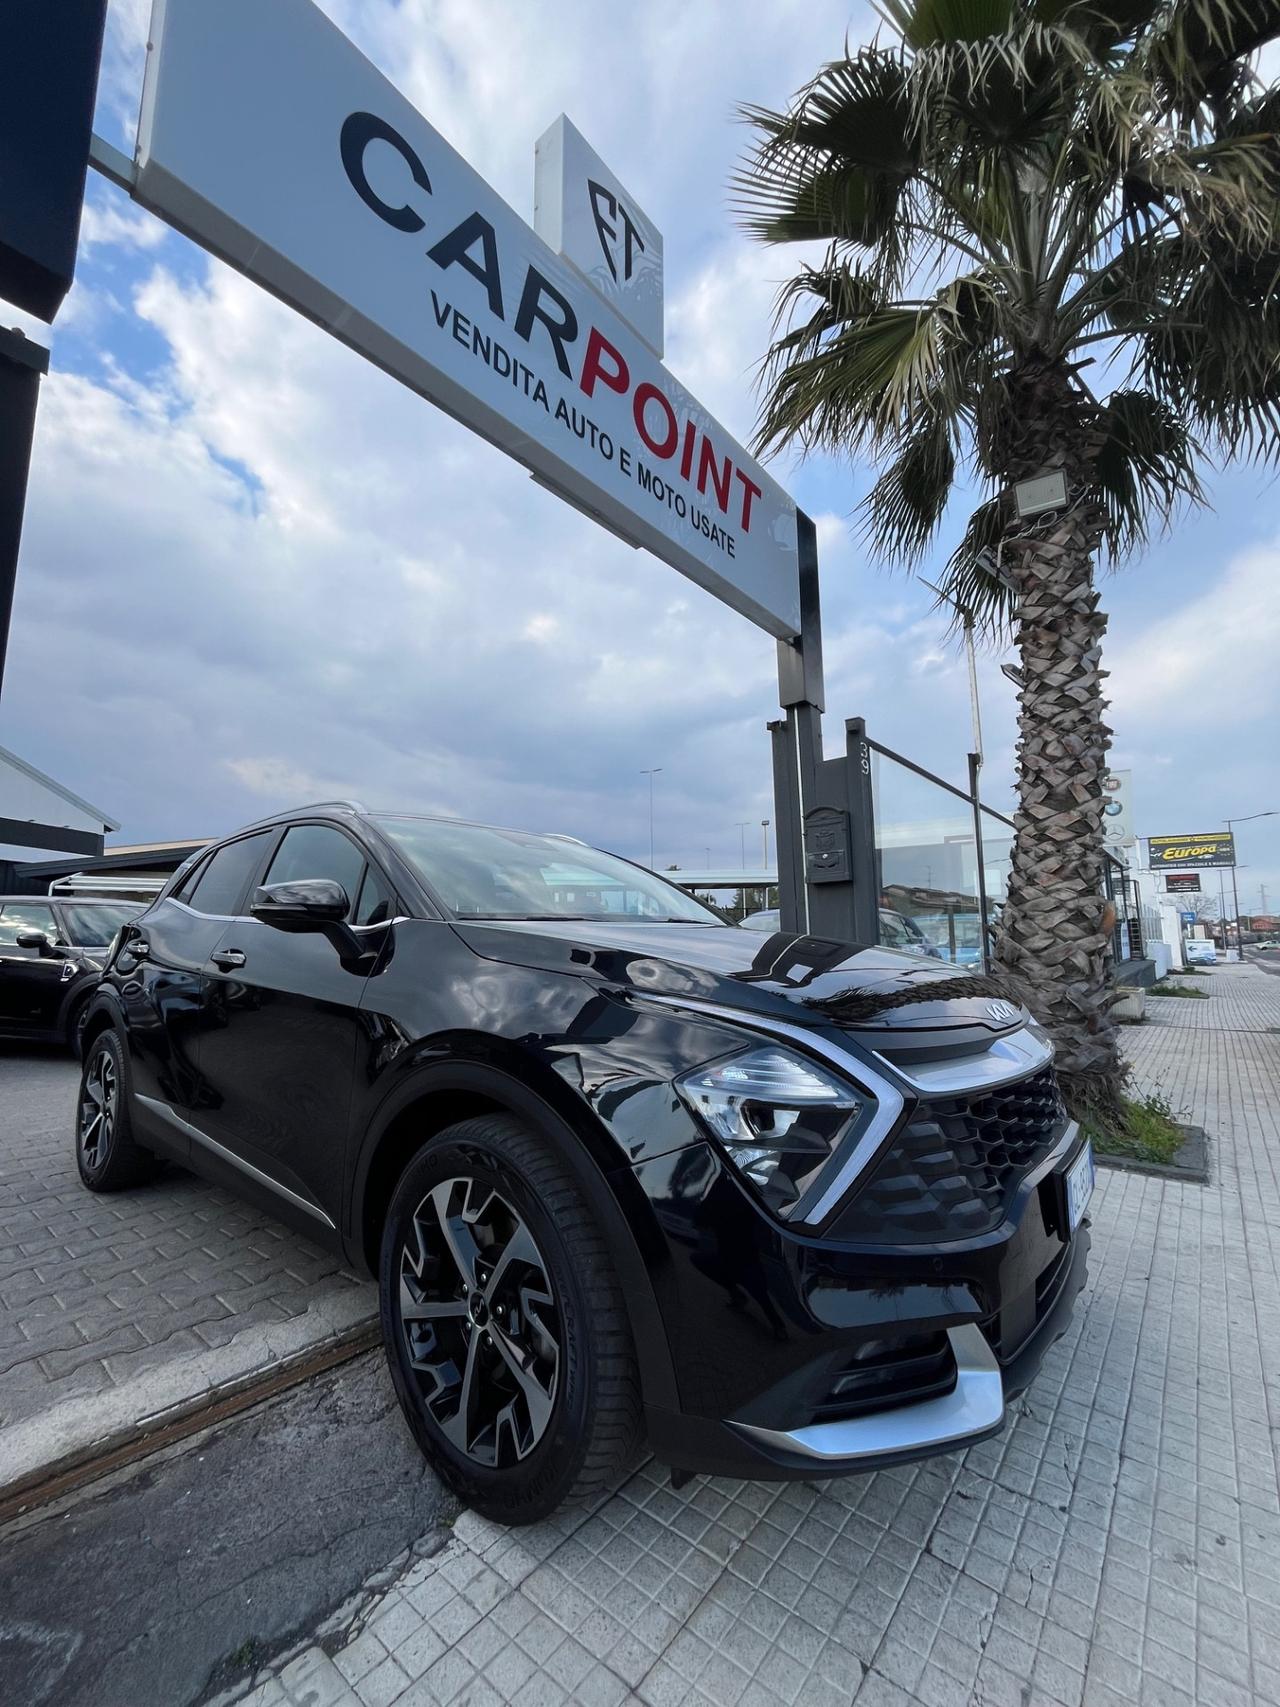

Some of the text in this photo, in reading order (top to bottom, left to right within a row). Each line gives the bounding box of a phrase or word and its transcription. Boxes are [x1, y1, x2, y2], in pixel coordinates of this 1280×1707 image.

[340, 111, 762, 533] CARPOINT
[430, 289, 736, 559] VENDITA AUTO E MOTO USATE
[1162, 844, 1217, 861] Europa
